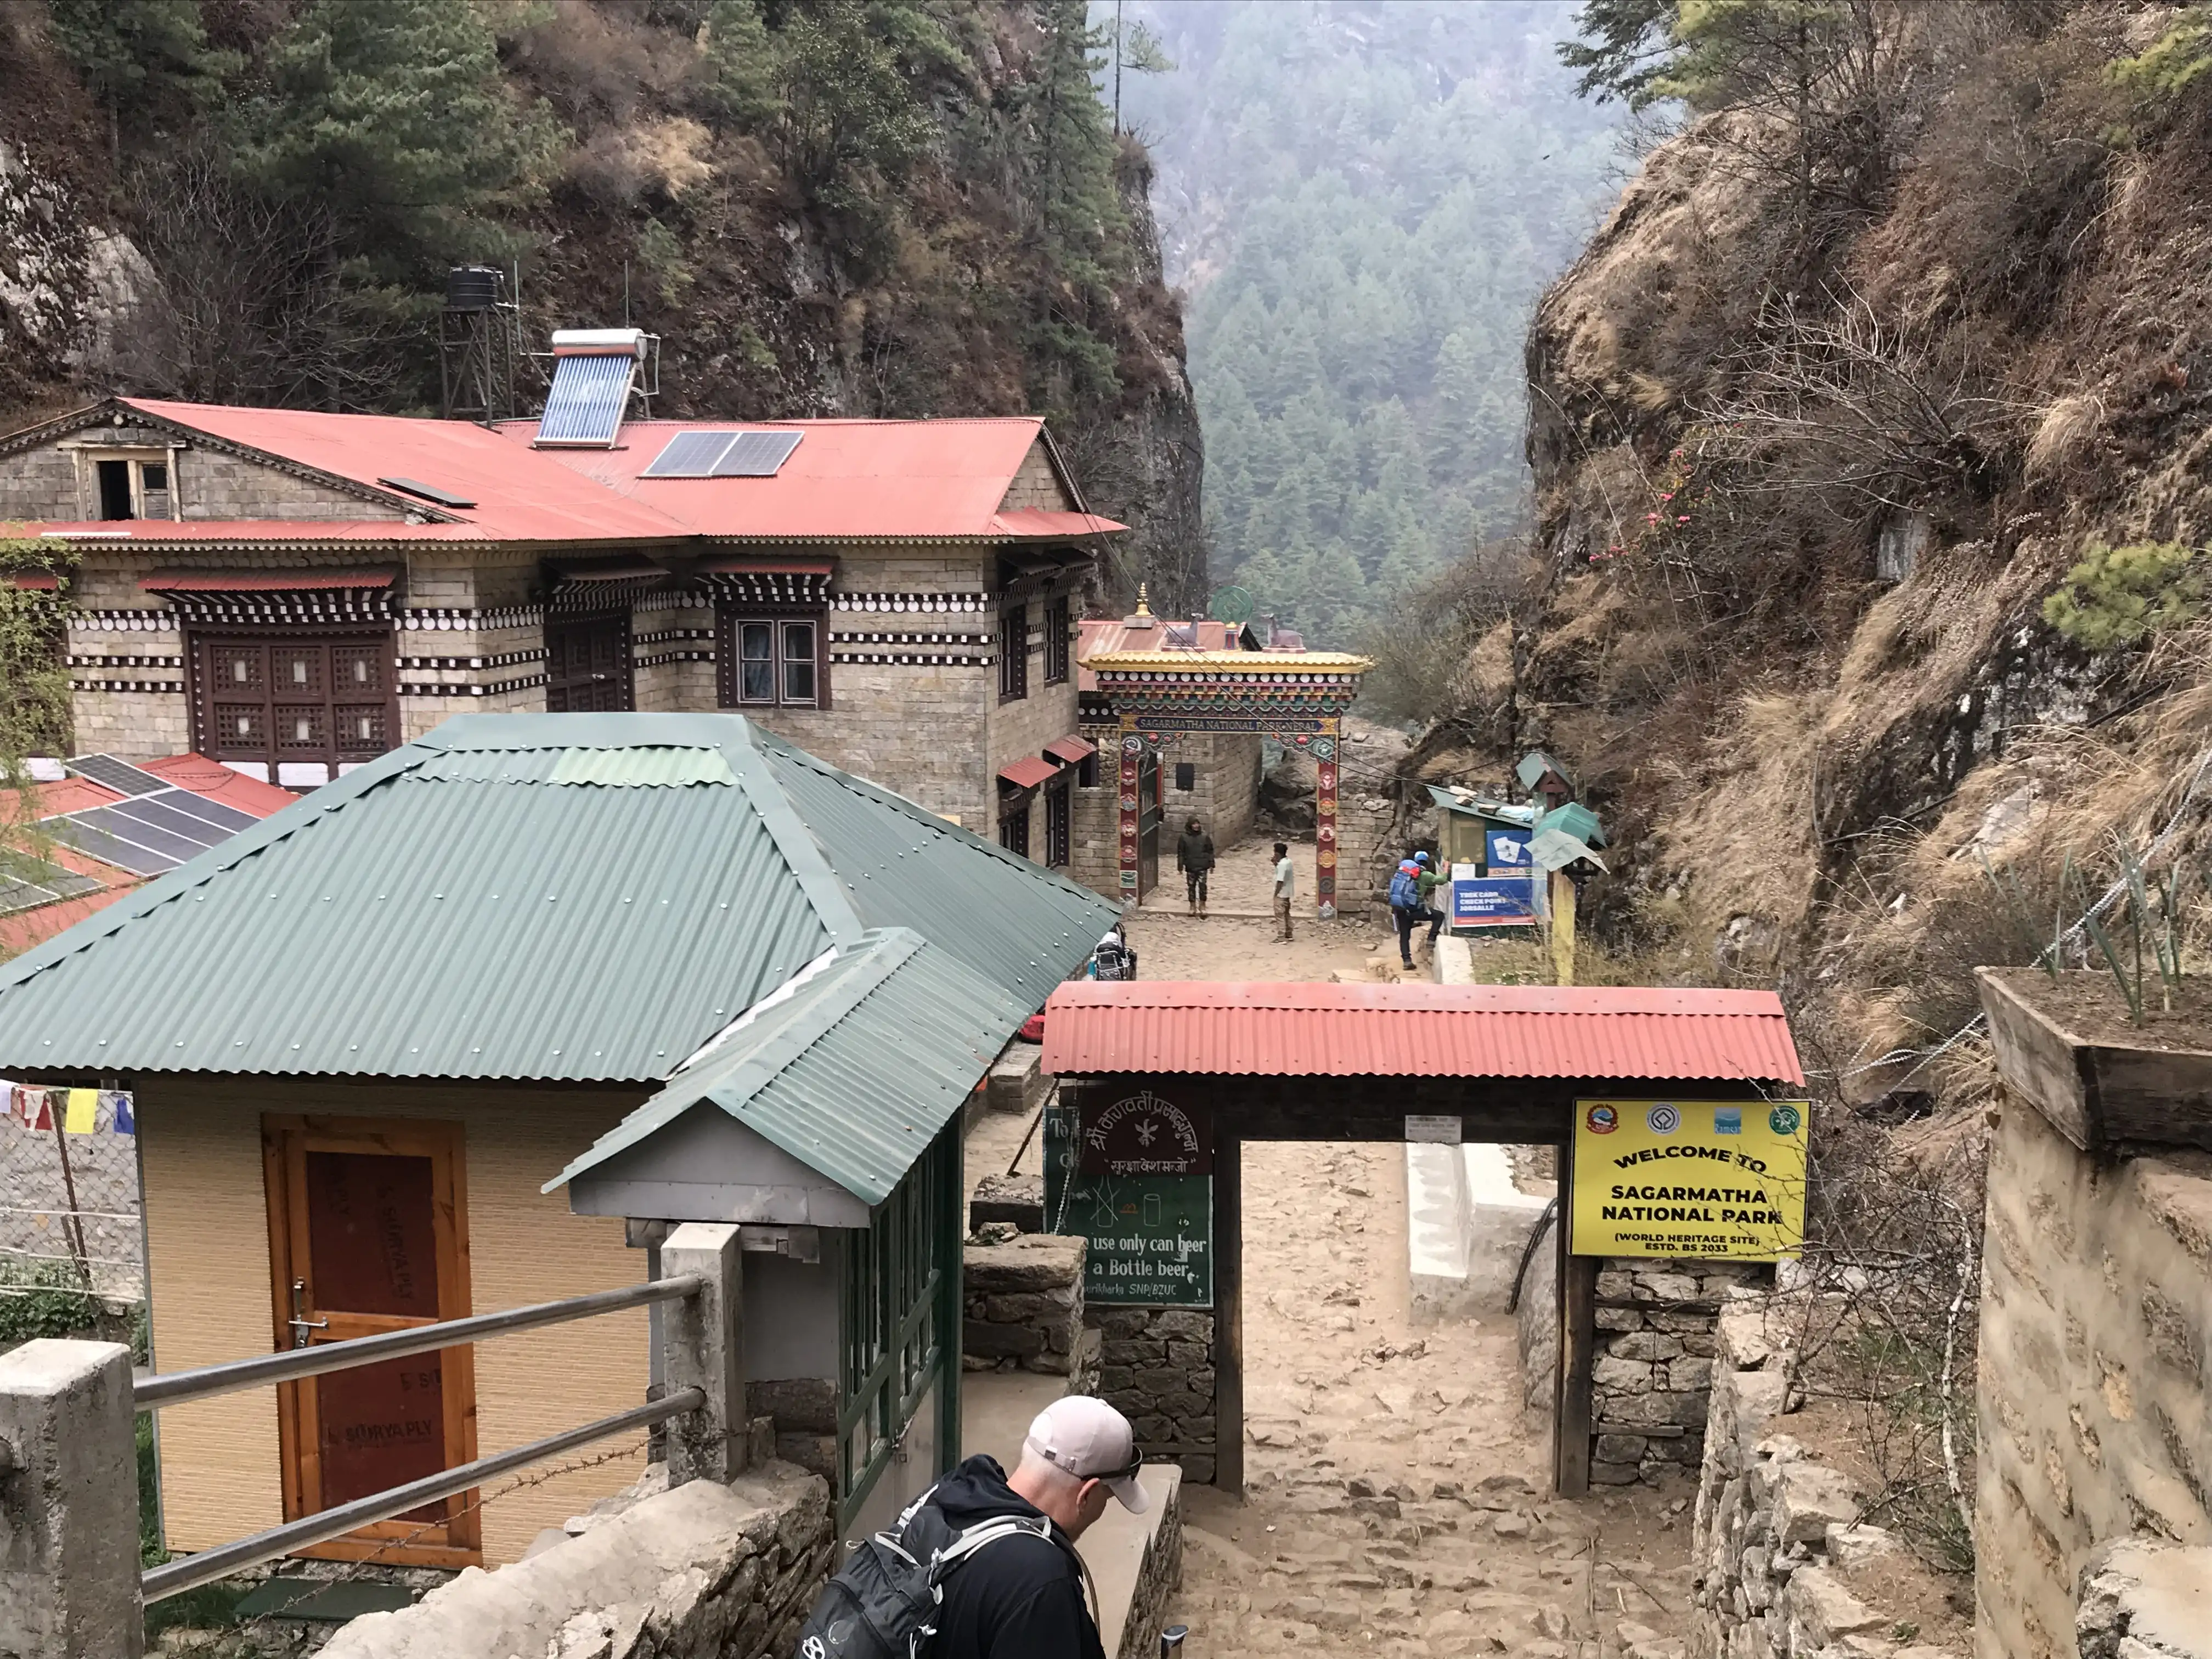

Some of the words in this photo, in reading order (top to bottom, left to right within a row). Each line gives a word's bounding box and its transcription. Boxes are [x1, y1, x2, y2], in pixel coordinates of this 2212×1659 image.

[1141, 719, 1205, 730] SAGARMATHA
[1206, 720, 1254, 730] NATIONAL
[1613, 1146, 1733, 1169] WELCOME
[1736, 1154, 1767, 1173] TO
[1611, 1185, 1768, 1204] SAGARMATHA
[1602, 1206, 1714, 1222] NATIONAL
[1722, 1209, 1783, 1224] PARK
[1093, 1237, 1115, 1251] use
[1119, 1233, 1147, 1256] only
[1150, 1237, 1174, 1252] can
[1178, 1233, 1207, 1254] beer
[1615, 1233, 1664, 1243] (WORLD
[1667, 1234, 1726, 1244] HERITAGE
[1730, 1236, 1760, 1246] SITE)
[1645, 1243, 1678, 1251] ESTD.
[1682, 1244, 1697, 1252] BS
[1701, 1244, 1729, 1252] 2033
[1092, 1264, 1103, 1276] a
[1109, 1259, 1153, 1276] Bottle
